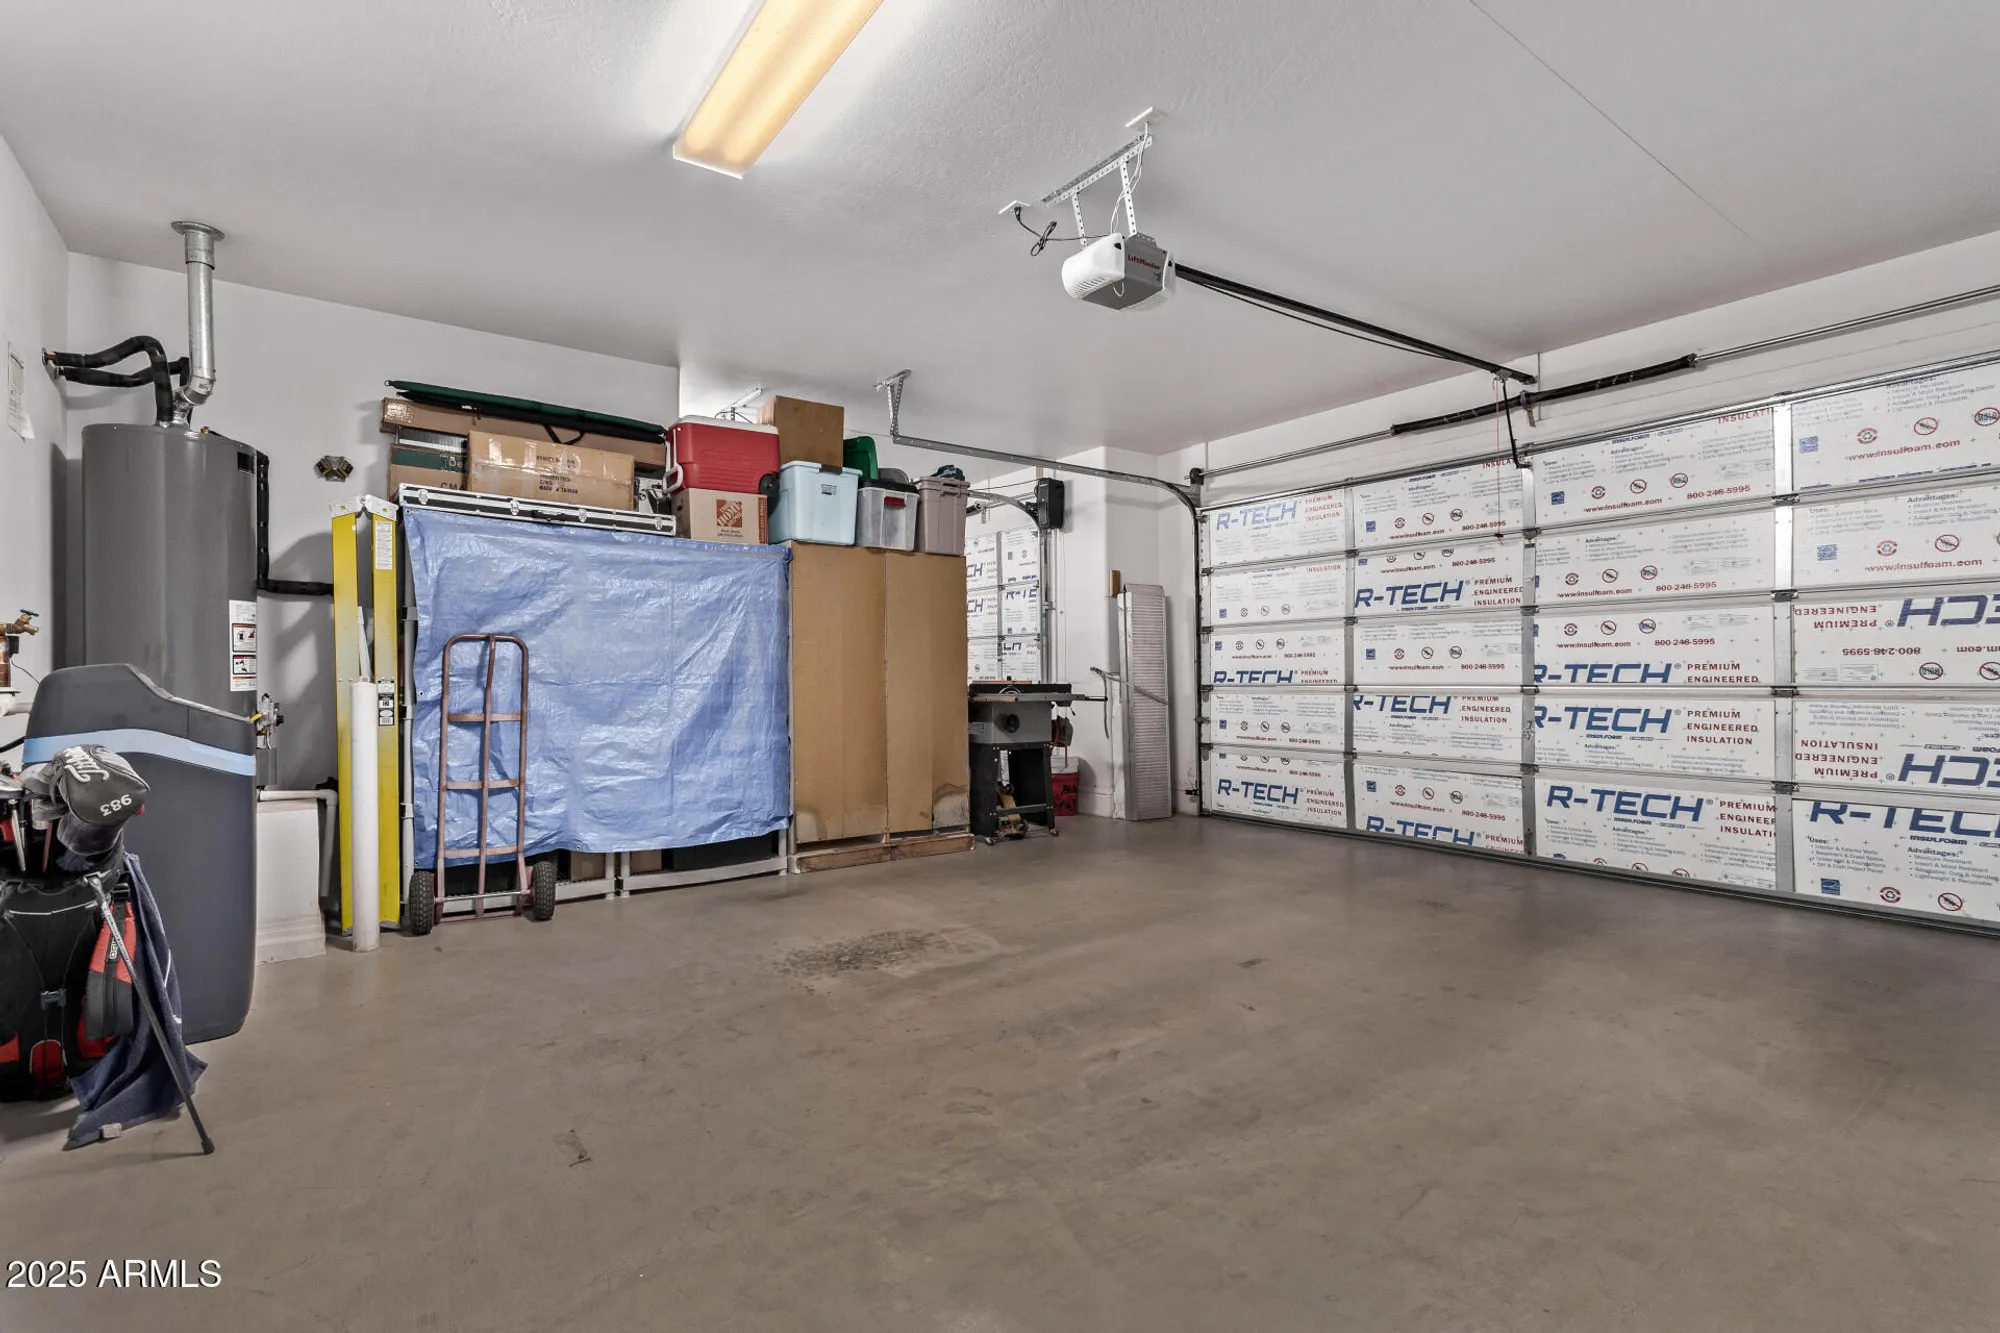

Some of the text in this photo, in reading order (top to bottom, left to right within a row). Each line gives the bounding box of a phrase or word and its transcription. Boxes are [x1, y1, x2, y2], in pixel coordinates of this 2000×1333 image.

[1585, 485, 1751, 513] www.insulfoam.com 800-248-5995
[1216, 500, 1298, 530] R-TECH
[1867, 559, 1982, 572] www.insulfoam.com
[1474, 577, 1513, 585] PREMIUM
[1354, 580, 1464, 608] R-TECH
[1559, 581, 1717, 598] www.insulfoam.com 800-248-5995
[1474, 597, 1521, 606] INSULATION
[1794, 605, 1877, 616] ENGINEERED
[1814, 620, 1877, 629] PREMIUM
[1558, 638, 1715, 649] www.insulfoam.com 800-248-5995
[1842, 647, 1921, 656] 800-248-5995
[1534, 663, 1672, 683] R-TECH
[1461, 705, 1511, 713] ENGINEERED
[1687, 710, 1741, 718] PREMIUM
[1535, 706, 1672, 733] R-TECH
[1687, 723, 1758, 732] ENGINEERED
[1687, 735, 1753, 745] INSULATION
[1801, 739, 1878, 750] INSULATION
[1794, 753, 1878, 765] ENGINEERED
[1814, 767, 1878, 779] PREMIUM
[1218, 779, 1299, 805] R-TECH
[1306, 789, 1335, 797] PREMIUM
[100, 794, 132, 816] 983
[1547, 785, 1704, 822] R-TECH
[1720, 800, 1776, 812] PREMIUM
[1307, 807, 1342, 816] INSULATION
[1485, 834, 1523, 845] PREMIUM
